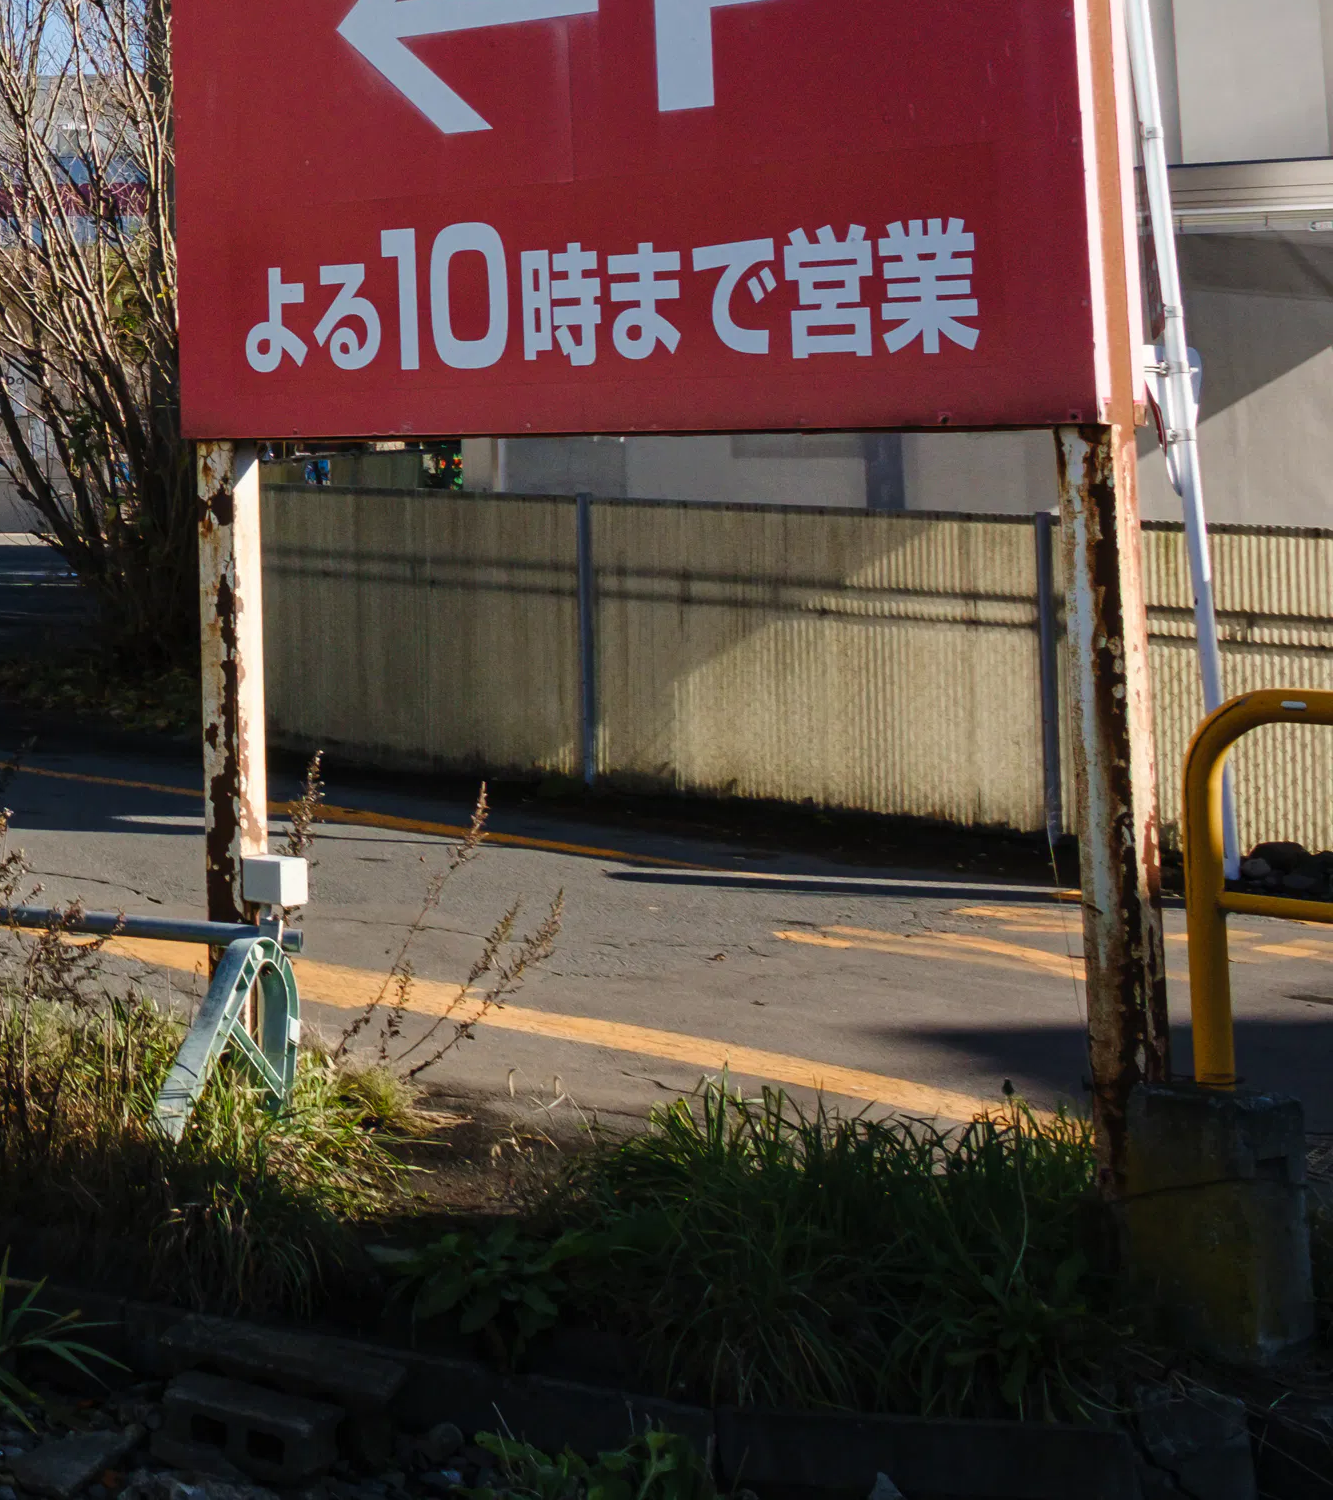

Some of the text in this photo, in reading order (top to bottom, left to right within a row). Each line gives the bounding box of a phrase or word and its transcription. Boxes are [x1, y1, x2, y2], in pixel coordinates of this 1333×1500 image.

[244, 217, 981, 374] よる10時まで営業
